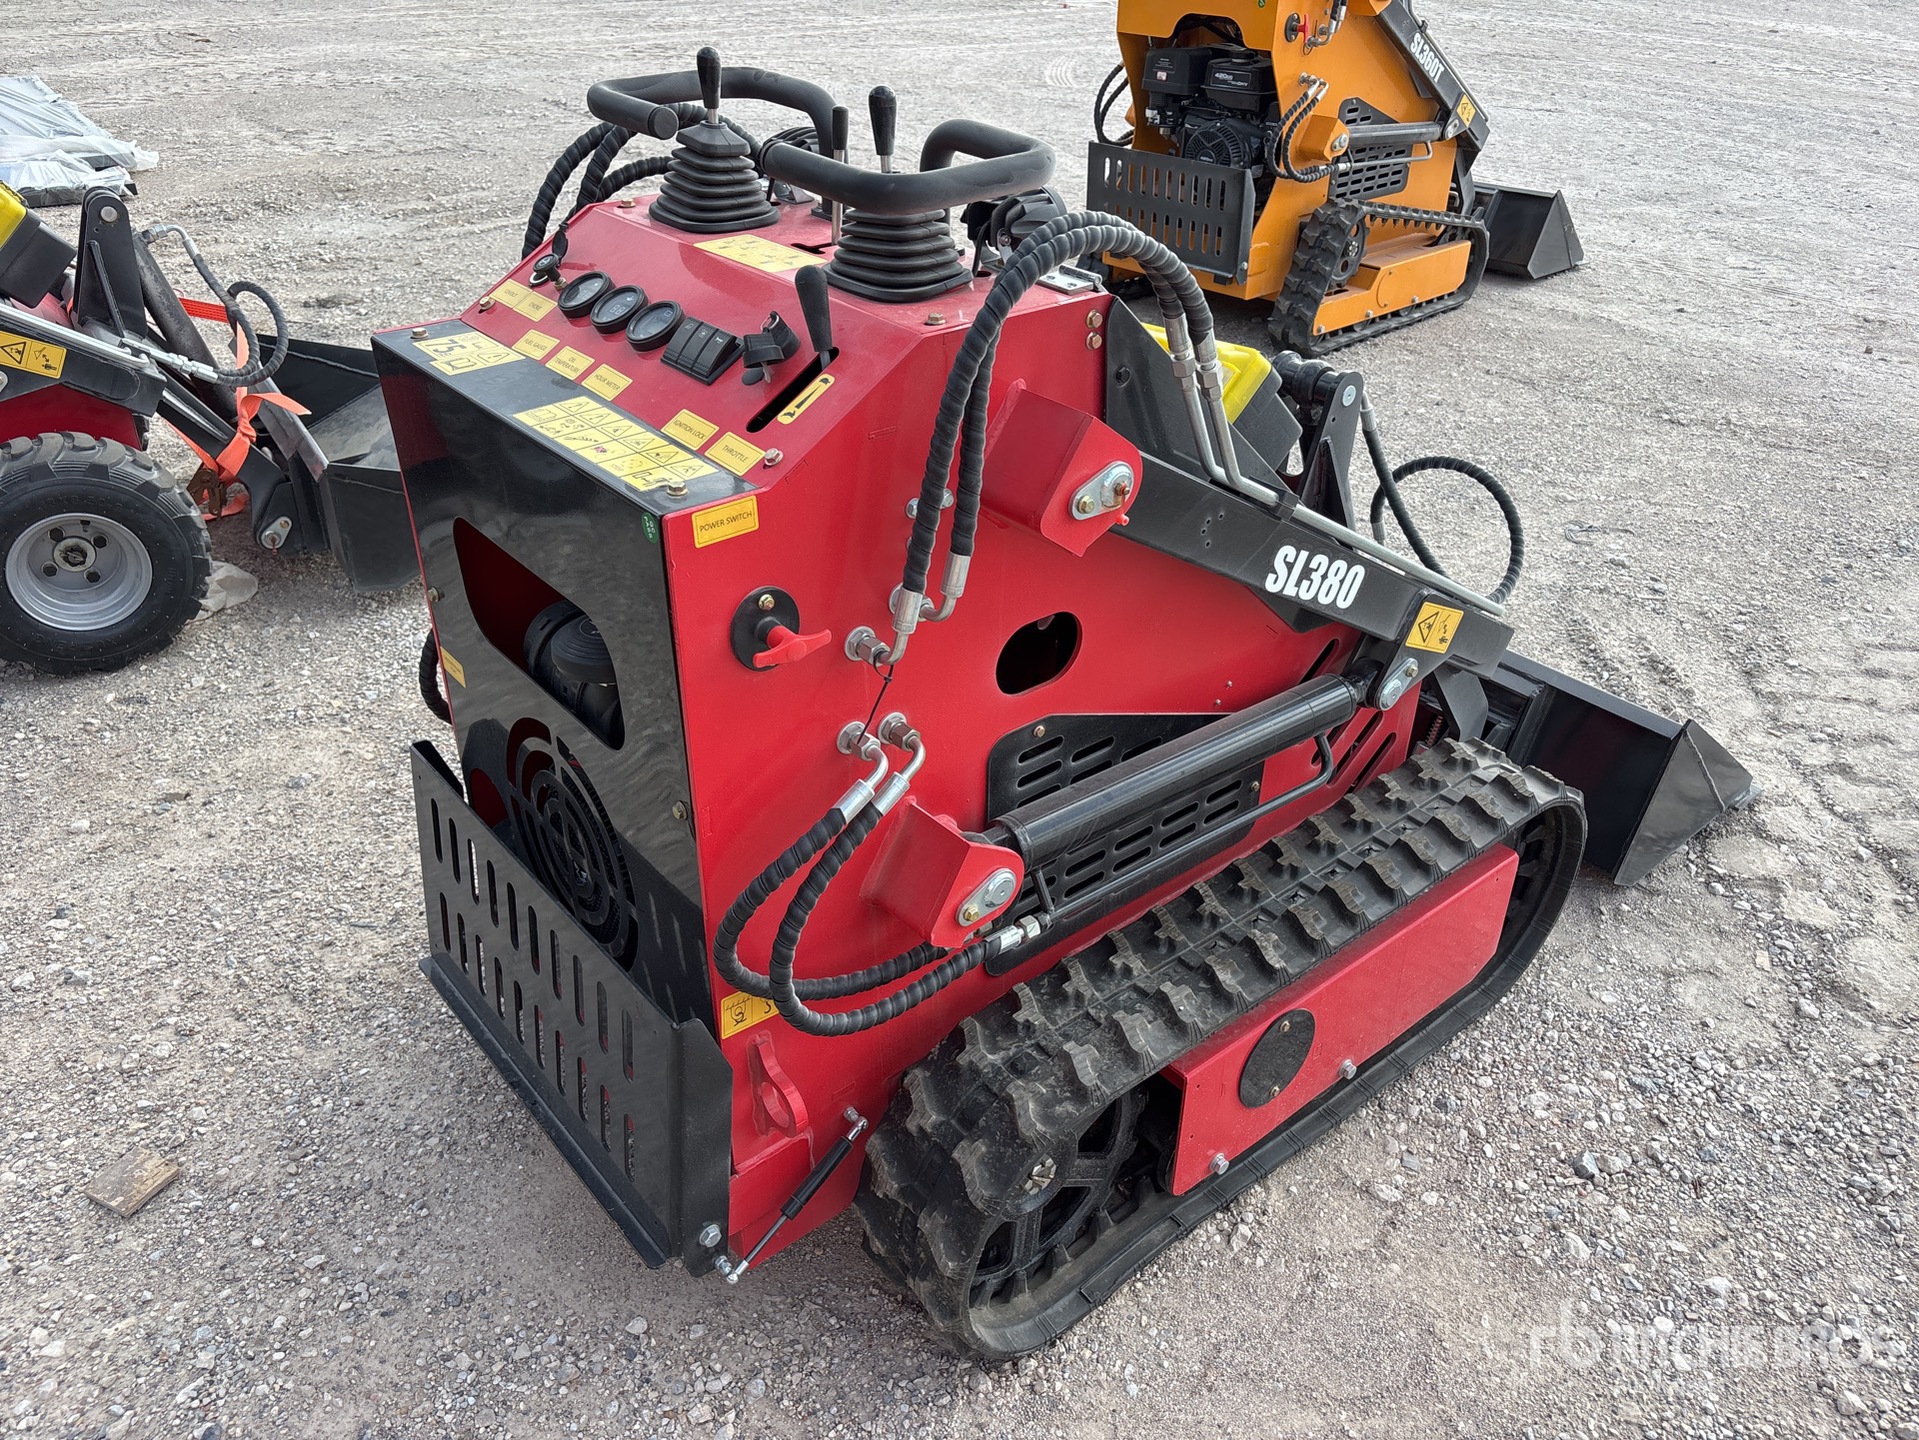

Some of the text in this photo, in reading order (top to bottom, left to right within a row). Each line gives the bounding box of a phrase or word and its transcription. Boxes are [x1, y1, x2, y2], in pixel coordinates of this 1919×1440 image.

[1410, 32, 1445, 83] SL360T
[524, 338, 548, 352] FUEL GAUGE
[554, 357, 580, 374] TEMPERATURE
[594, 373, 620, 391] HOUR METER
[673, 419, 706, 440] IGNITION LOCK
[722, 444, 749, 463] THROTTLE
[700, 510, 753, 532] POWER SWITCH
[1264, 545, 1366, 610] SL380
